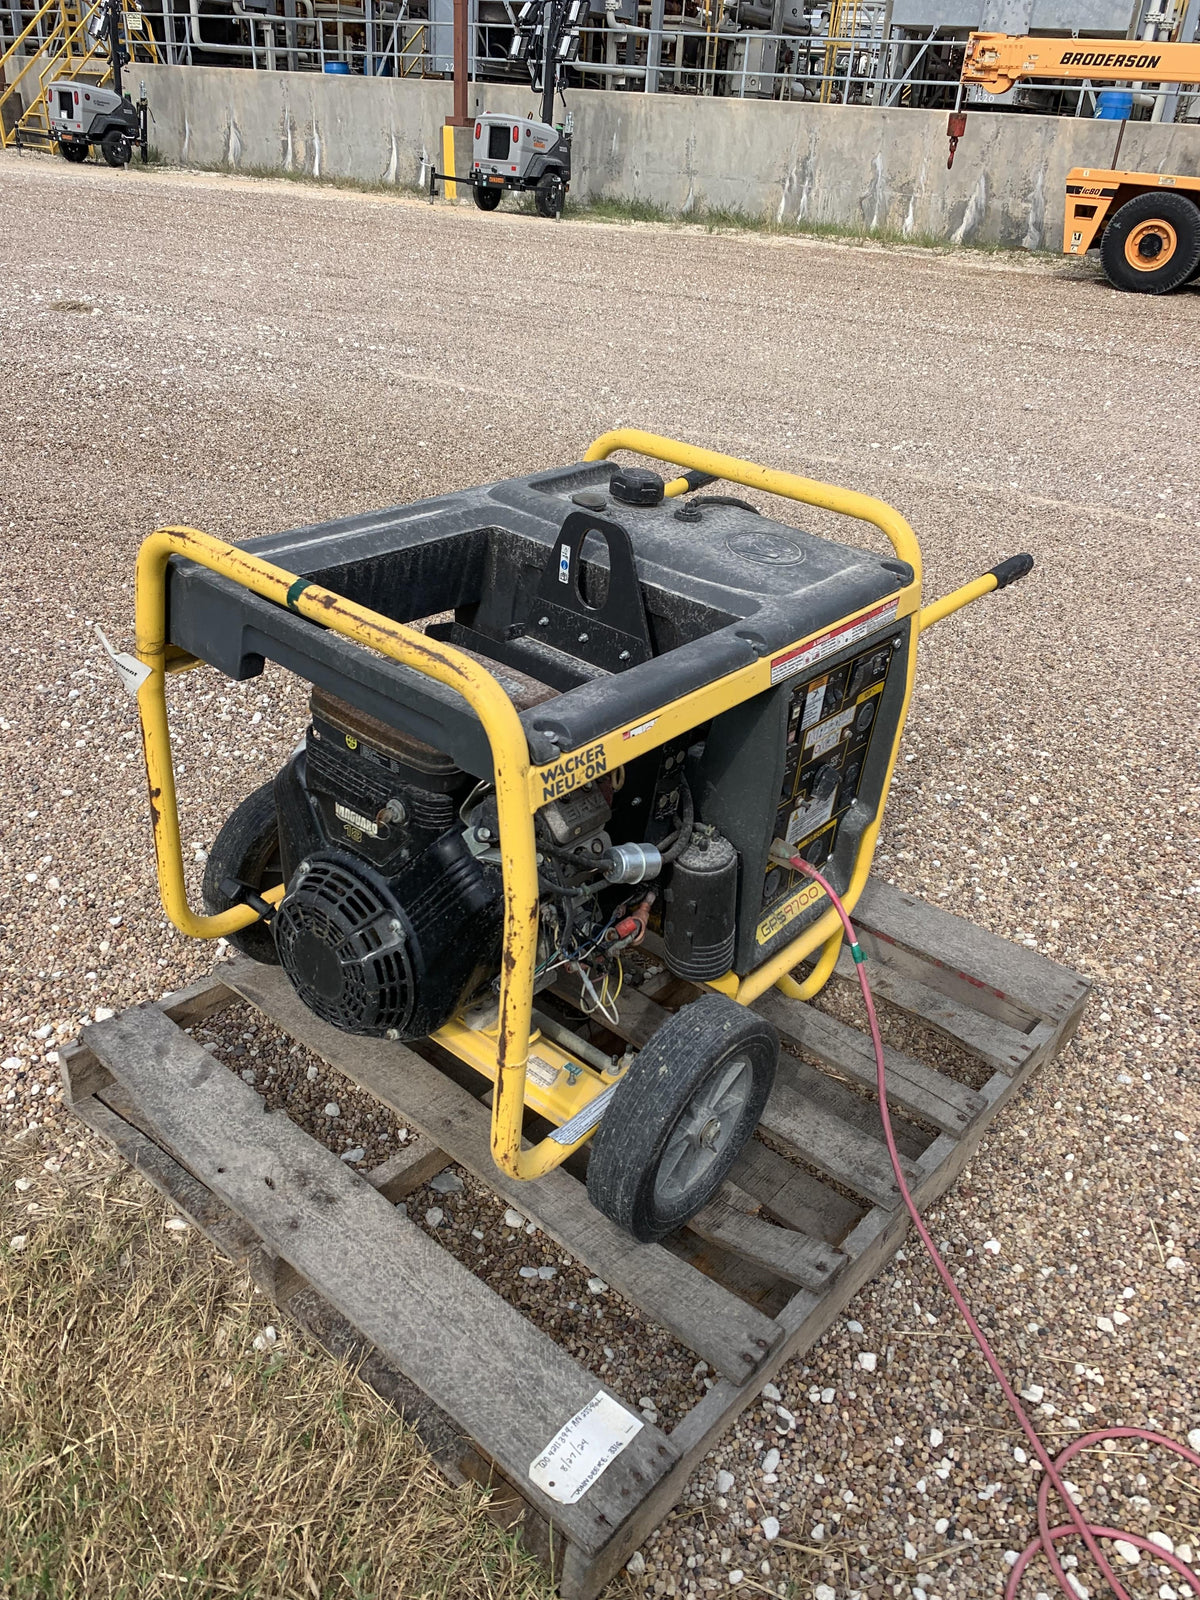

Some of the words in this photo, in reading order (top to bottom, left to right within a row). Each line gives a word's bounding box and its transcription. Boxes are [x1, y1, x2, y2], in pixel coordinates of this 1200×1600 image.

[1060, 52, 1162, 69] BRODERSON
[540, 743, 606, 785] WACKER
[542, 758, 607, 802] NEUON
[335, 801, 378, 835] VANGUARD
[760, 886, 820, 938] GPS9700
[559, 1438, 590, 1472] 8/27/24
